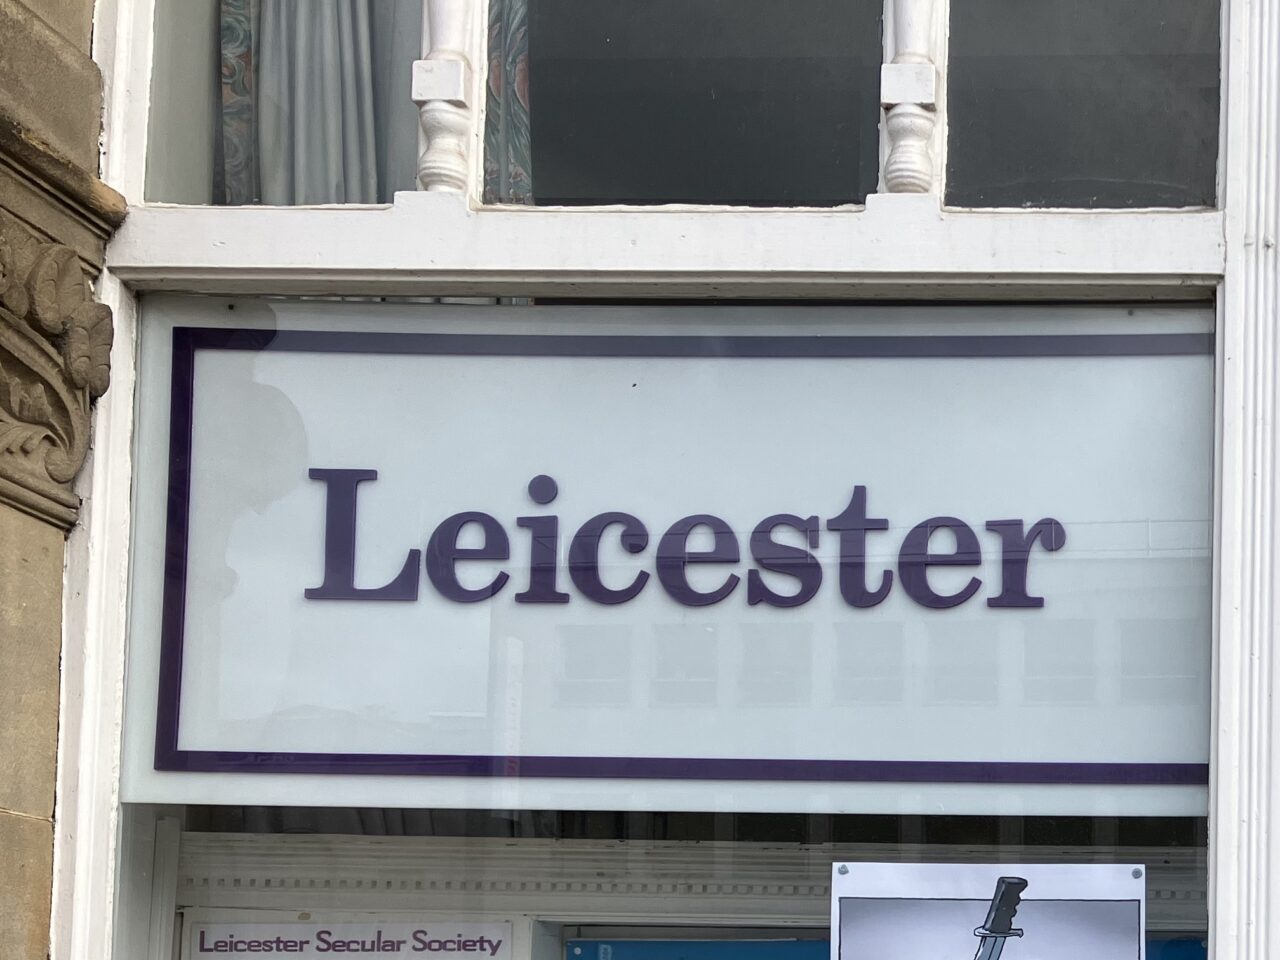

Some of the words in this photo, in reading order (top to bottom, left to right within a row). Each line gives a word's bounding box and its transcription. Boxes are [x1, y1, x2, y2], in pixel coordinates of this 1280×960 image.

[304, 467, 1066, 609] Leicester
[199, 930, 309, 952] Leicester
[316, 930, 406, 952] Secular
[412, 929, 502, 956] Society
